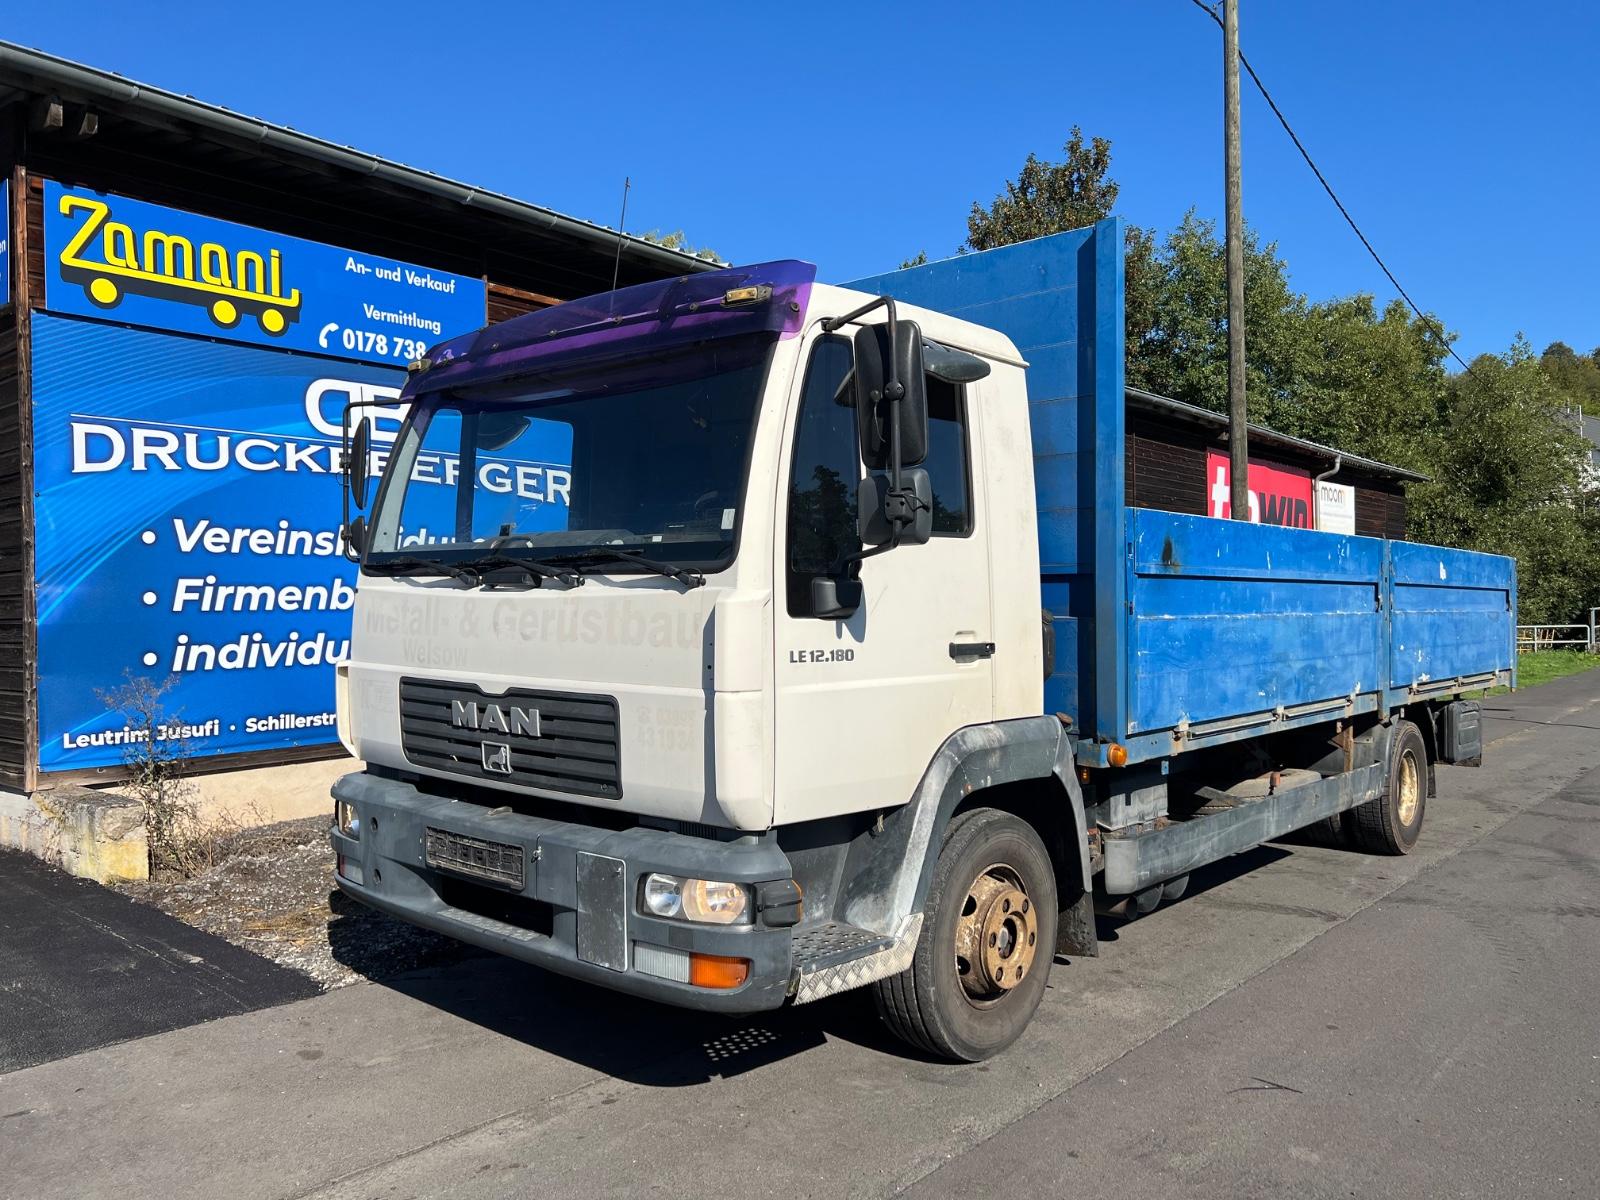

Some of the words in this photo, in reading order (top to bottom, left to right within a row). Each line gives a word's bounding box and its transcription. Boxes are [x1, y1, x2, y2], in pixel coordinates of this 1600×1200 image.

[60, 195, 299, 307] Zamani
[345, 257, 372, 275] An-
[376, 267, 401, 282] und
[405, 269, 455, 294] Verkauf
[363, 303, 441, 335] Vermittlung
[343, 328, 388, 355] 0178
[393, 337, 426, 360] 738
[172, 575, 355, 612] Firmenb
[172, 631, 350, 672] individu
[789, 650, 807, 663] LE
[810, 649, 855, 662] 12.180
[63, 726, 150, 749] Leutrim
[157, 719, 219, 741] Jusufi
[245, 711, 336, 733] Schillerstr
[452, 700, 541, 737] MAN
